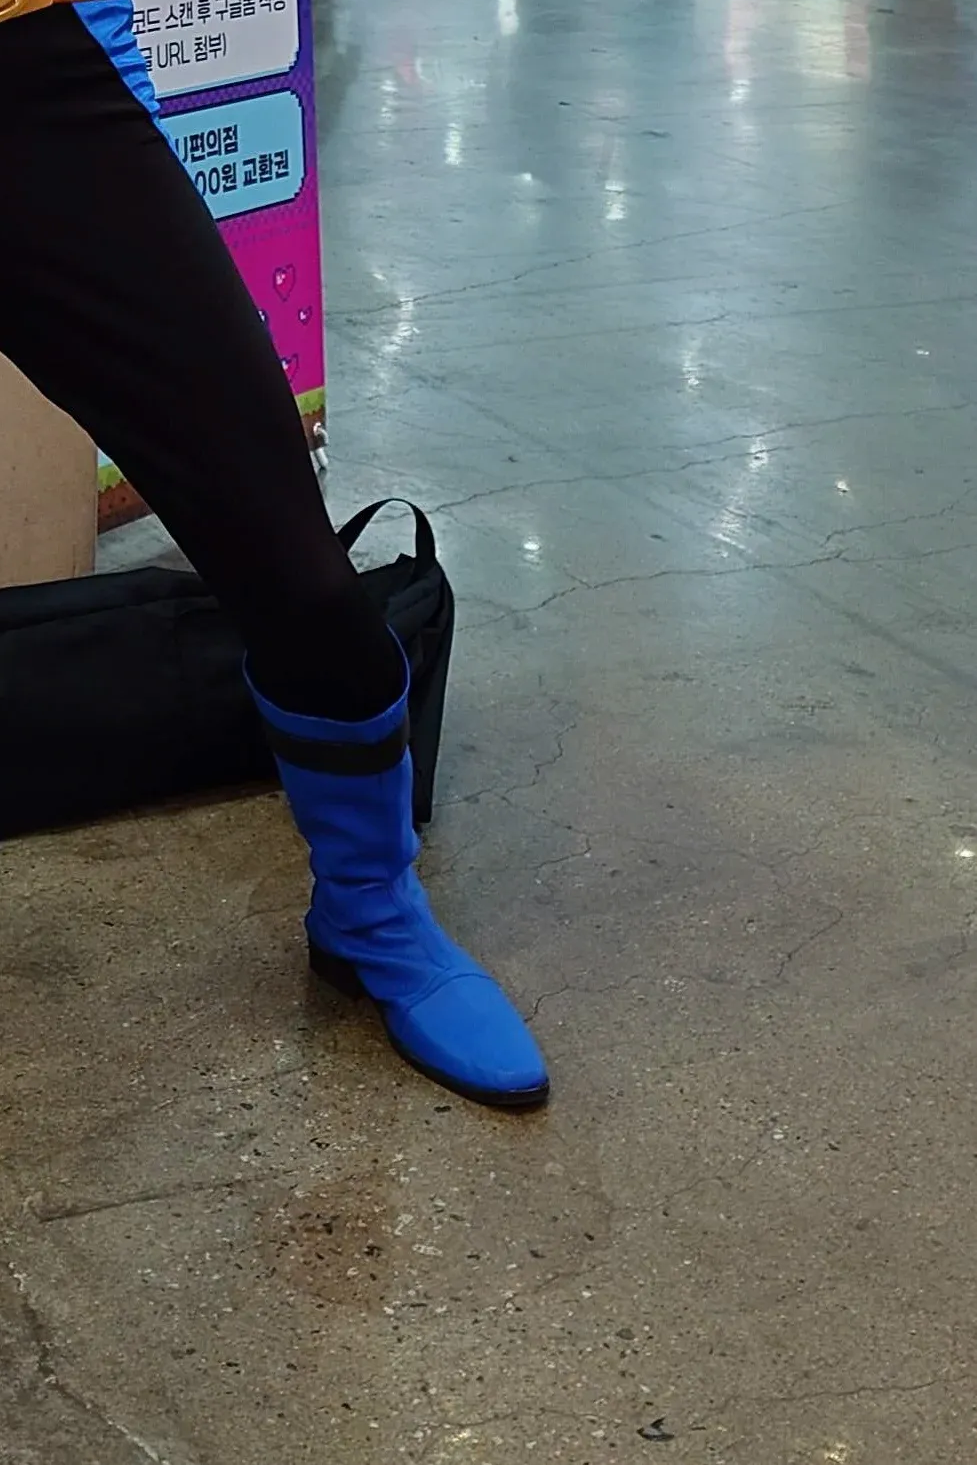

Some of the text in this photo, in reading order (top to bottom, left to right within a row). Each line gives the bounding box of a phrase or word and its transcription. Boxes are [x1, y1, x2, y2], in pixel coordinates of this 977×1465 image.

[132, 7, 161, 35] 코드
[165, 0, 194, 30] 스캔
[156, 39, 190, 69] URL
[194, 32, 227, 63] 첨부)
[242, 149, 290, 186] 교환권
